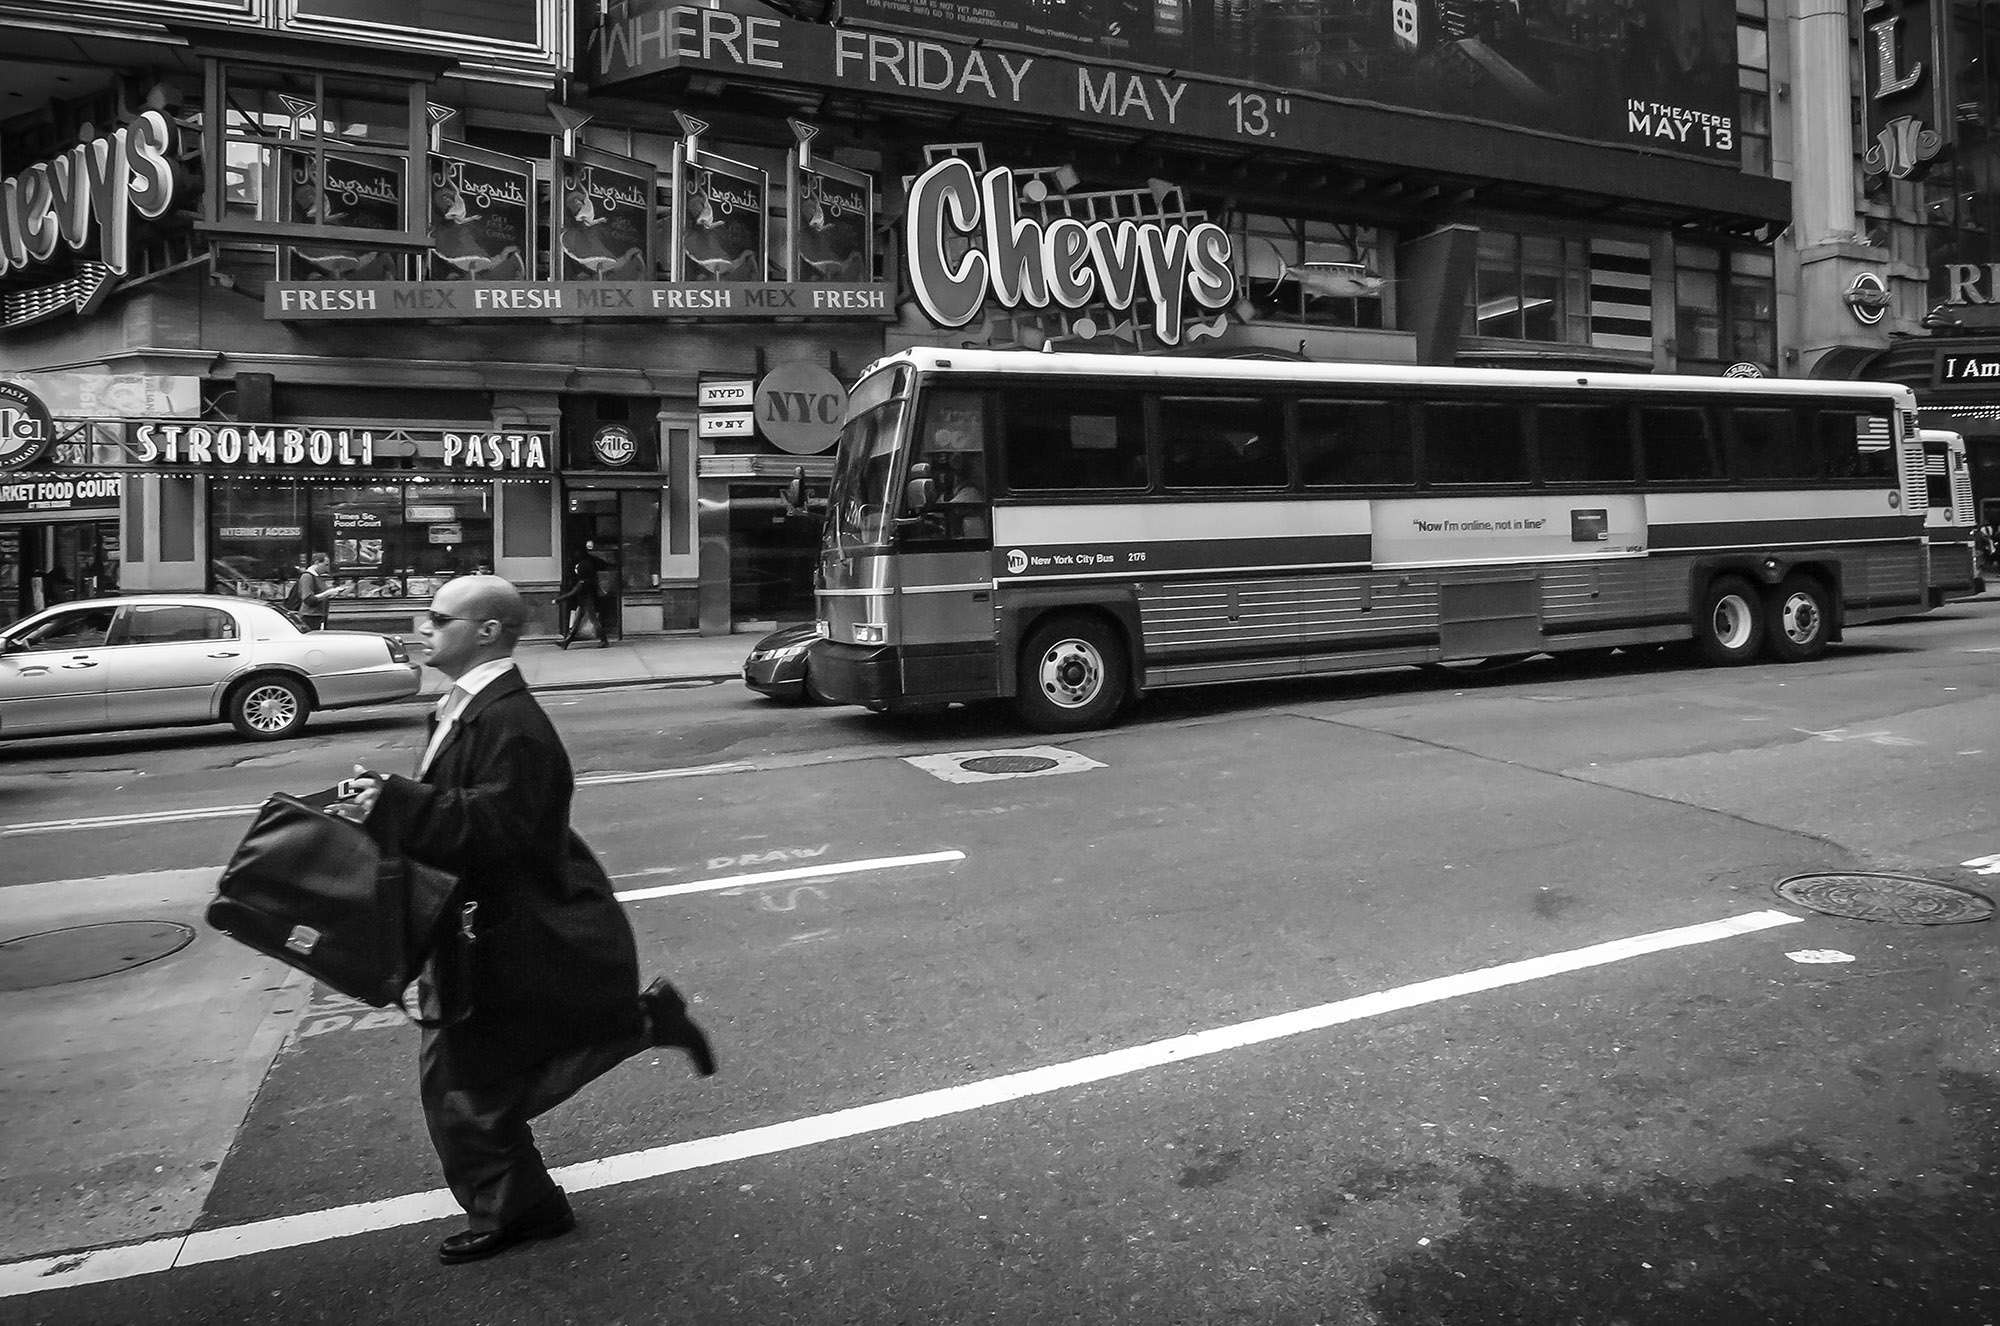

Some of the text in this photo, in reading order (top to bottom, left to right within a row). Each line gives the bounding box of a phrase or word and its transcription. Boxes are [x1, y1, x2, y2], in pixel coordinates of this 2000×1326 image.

[600, 5, 783, 75] WHERE
[835, 29, 1034, 102] FRIDAY
[1078, 67, 1188, 124] MAY
[1628, 98, 1732, 129] IN THEATERS
[1628, 112, 1733, 151] MAY 13
[907, 157, 1234, 346] Chevys
[280, 288, 885, 311] FRESH MEX FRESH MEX FRESH MEX FRESH
[708, 388, 745, 399] NYPD
[767, 391, 839, 425] NYC
[708, 420, 745, 430] I NY
[136, 424, 374, 466] STROMBOLI
[443, 434, 546, 469] PASTA
[595, 435, 635, 452] villa
[10, 444, 40, 464] SALADS
[38, 481, 74, 500] FOOD
[76, 479, 121, 499] COURT
[220, 527, 301, 537] INTERNET ACCESS
[334, 520, 356, 528] Food
[1461, 519, 1494, 532] online,
[1495, 520, 1512, 530] not
[1514, 519, 1522, 530] in
[1031, 557, 1051, 566] New
[1053, 555, 1074, 564] York
[1076, 554, 1095, 565] City
[1096, 554, 1115, 563] Bus
[1128, 552, 1146, 562] 2176
